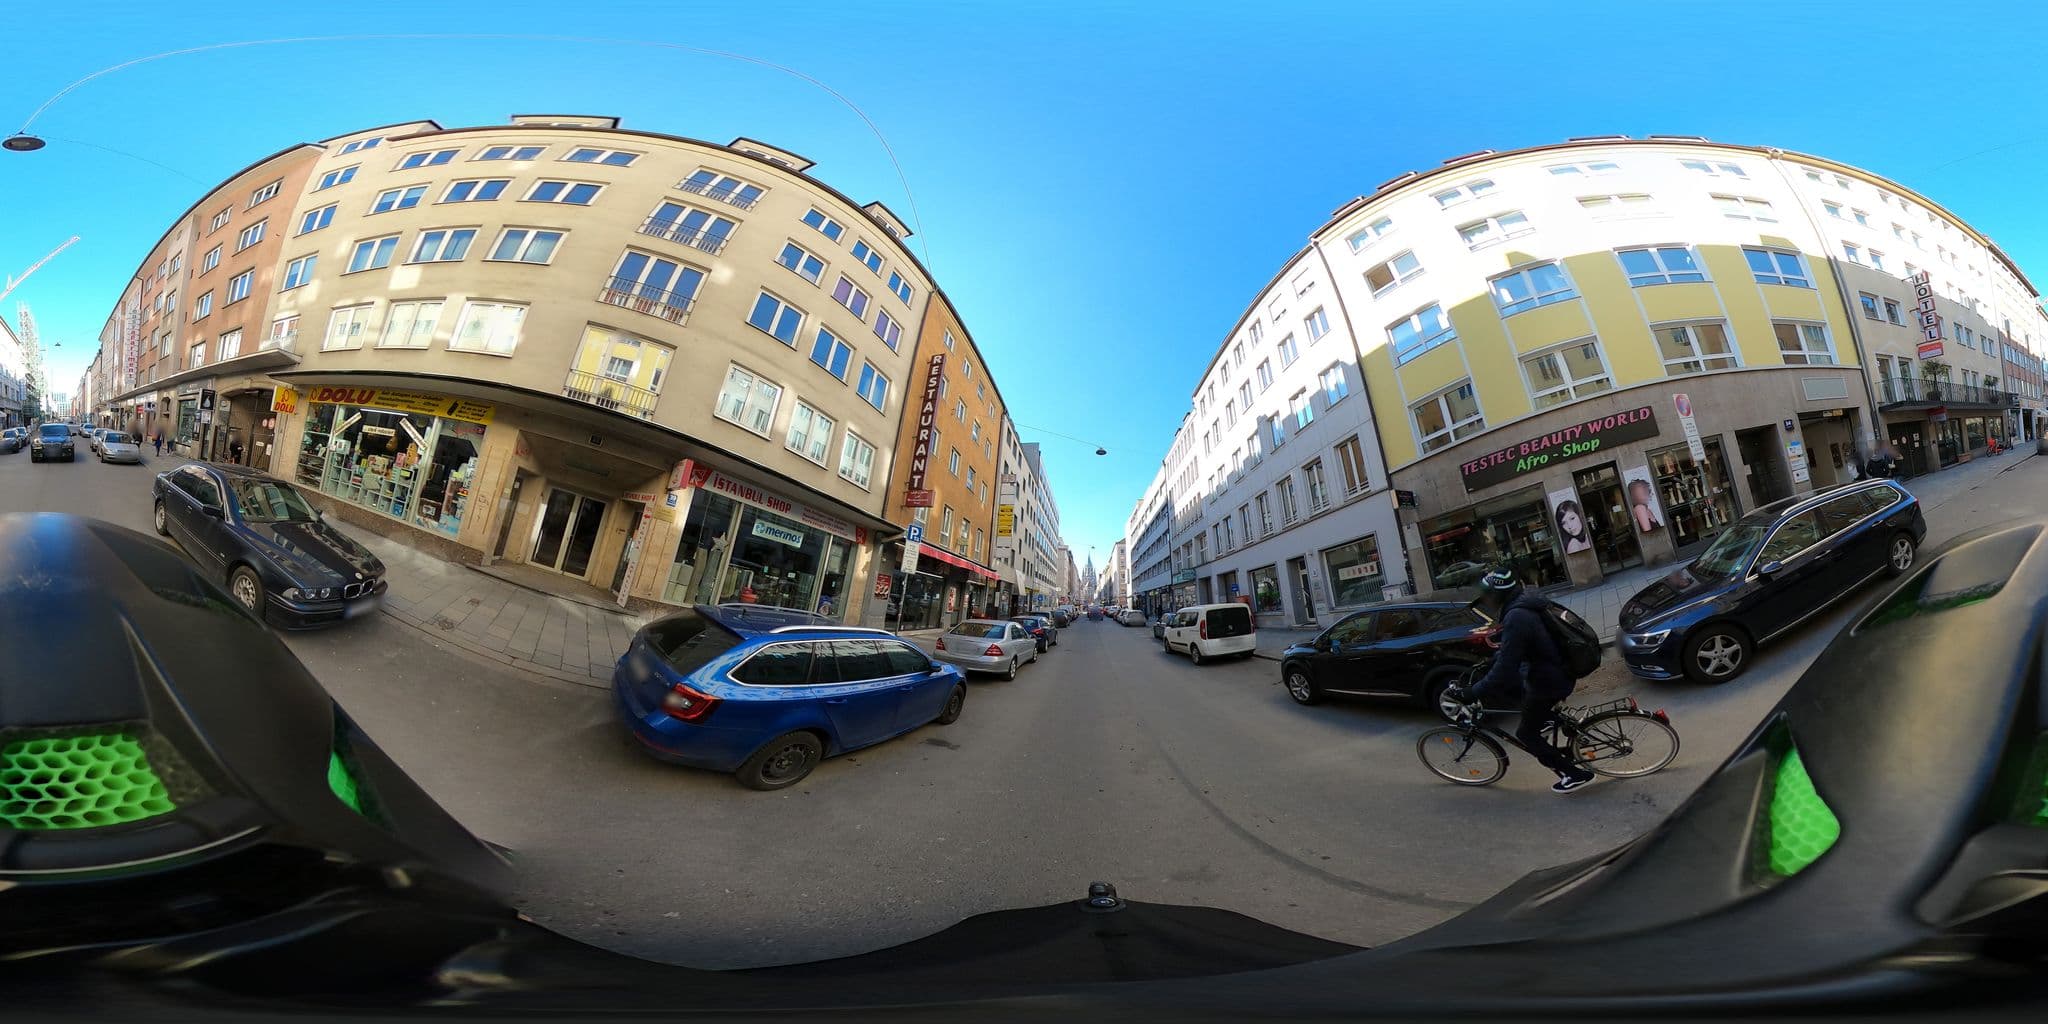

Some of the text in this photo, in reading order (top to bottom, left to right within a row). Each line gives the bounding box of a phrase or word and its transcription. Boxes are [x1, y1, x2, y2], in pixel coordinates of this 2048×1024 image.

[1914, 272, 1937, 340] HOTEL
[318, 387, 376, 404] DOLU
[274, 402, 295, 413] DOLU
[912, 354, 944, 488] RESTAURANT
[1462, 407, 1650, 476] TESTEC BEAUTY WORLD
[1516, 452, 1549, 473] Afro
[1562, 437, 1600, 458] Shop
[766, 496, 792, 514] SHOP
[764, 523, 802, 545] merinos
[910, 526, 920, 540] P
